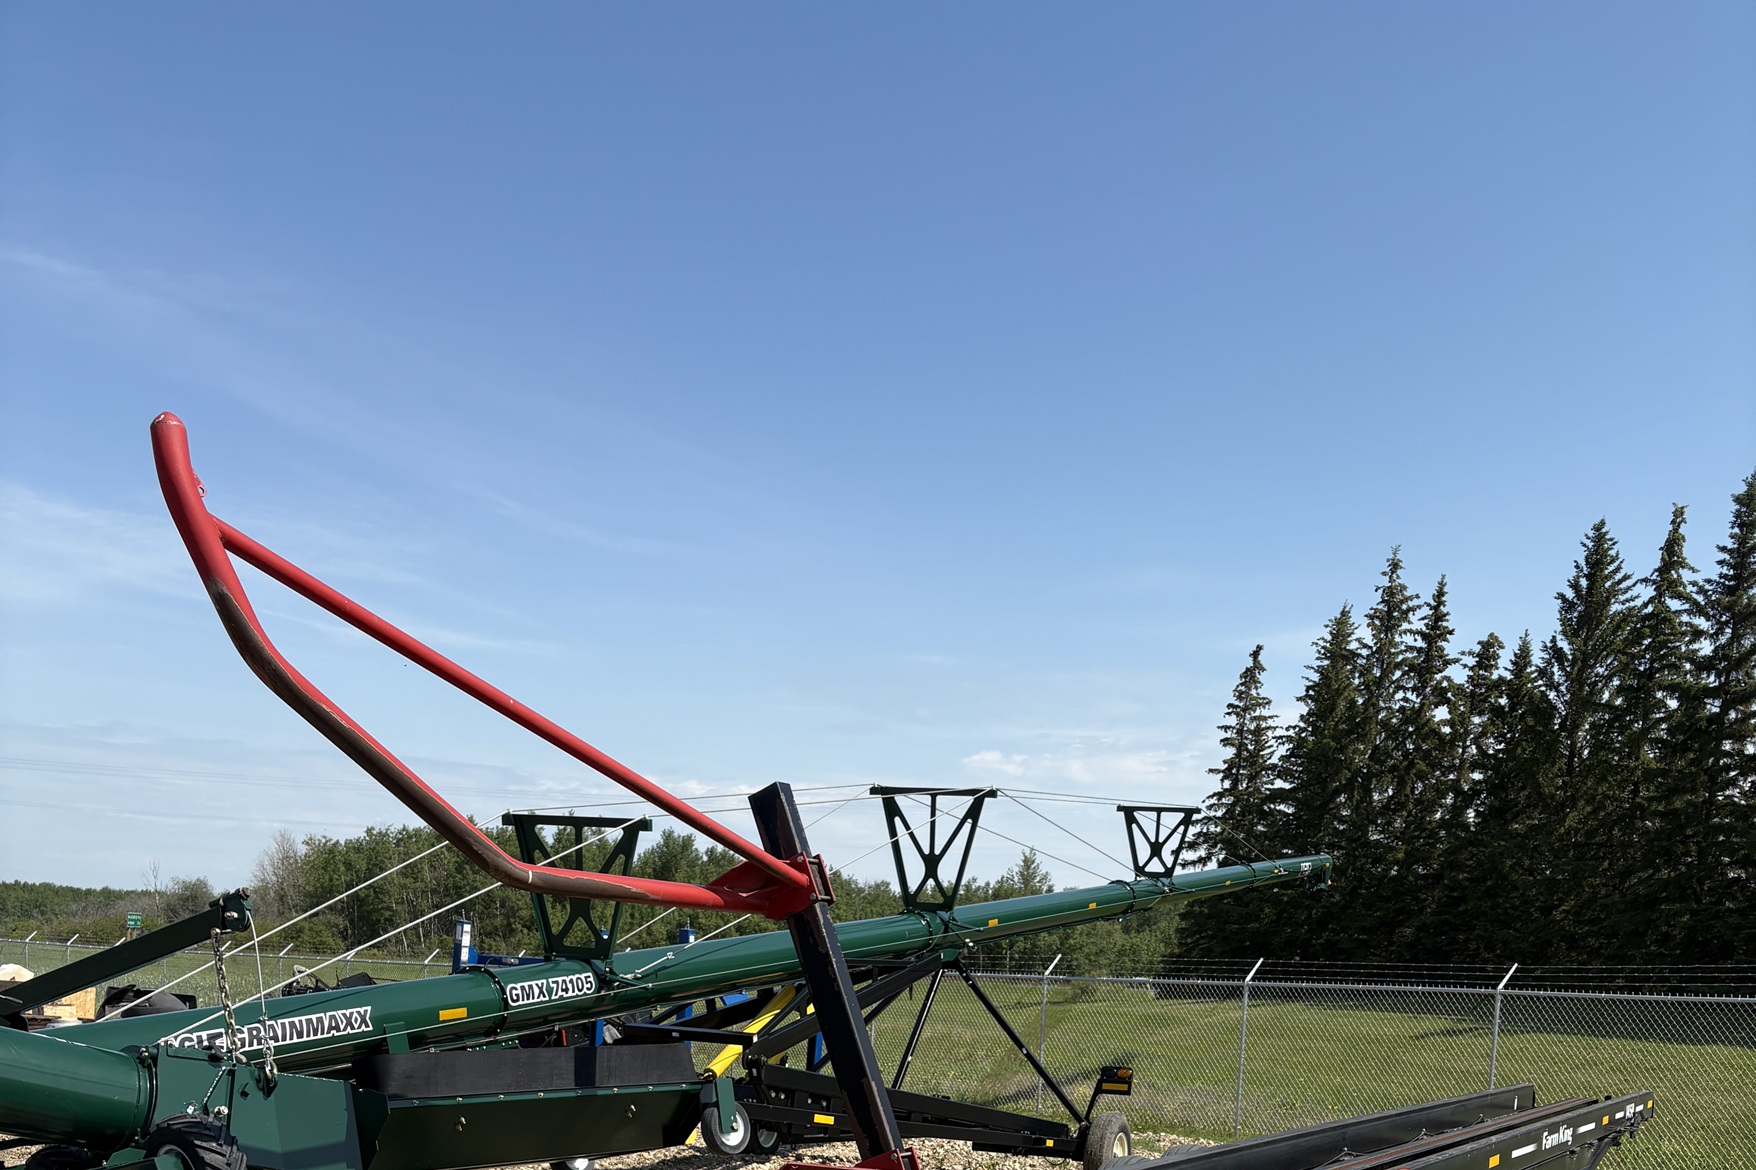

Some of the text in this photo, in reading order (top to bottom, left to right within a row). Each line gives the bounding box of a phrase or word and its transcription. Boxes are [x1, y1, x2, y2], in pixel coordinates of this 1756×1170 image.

[507, 972, 595, 1006] GMX 74105
[227, 1006, 373, 1053] GRAINMAXX
[1542, 1124, 1573, 1150] Farm King
